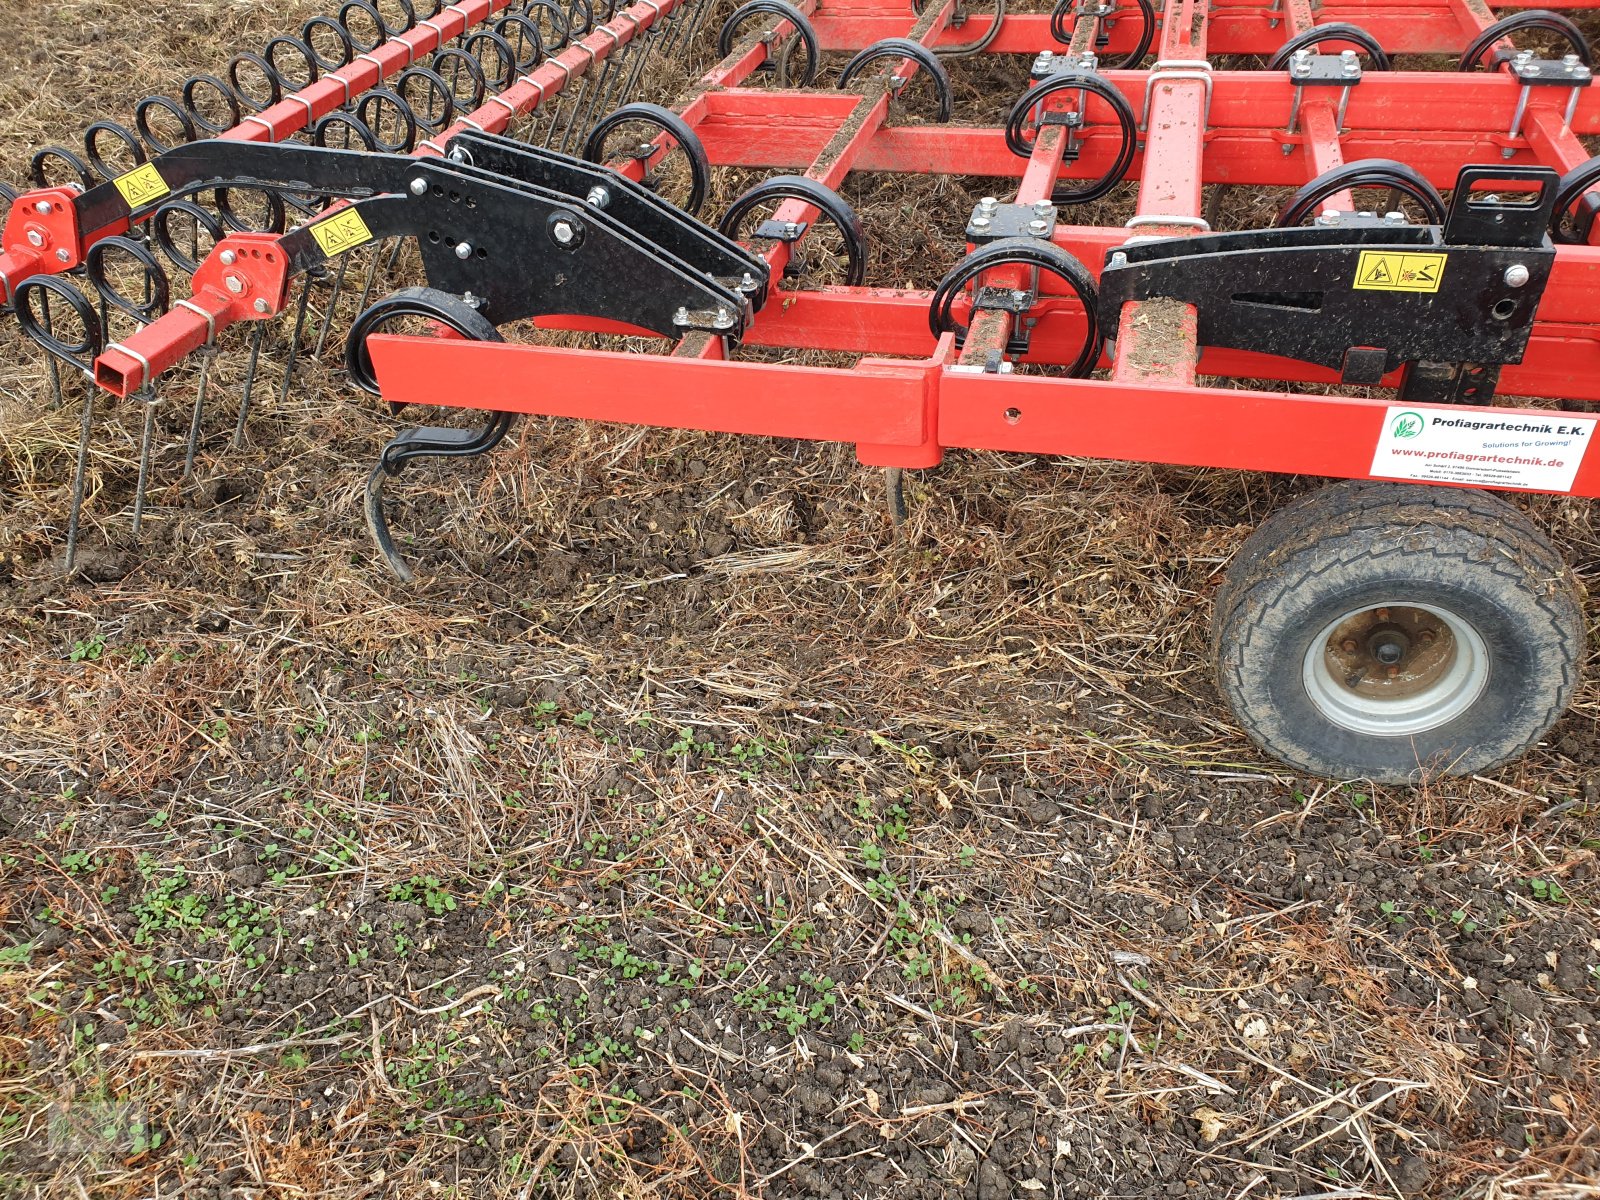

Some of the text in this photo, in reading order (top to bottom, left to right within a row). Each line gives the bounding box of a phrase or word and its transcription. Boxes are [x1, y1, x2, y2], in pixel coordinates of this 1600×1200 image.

[1432, 417, 1585, 436] Profiagrartechnik E.K.
[1482, 439, 1572, 449] Solutions for Growing!
[1391, 448, 1565, 468] www.profiagrartechnik.de
